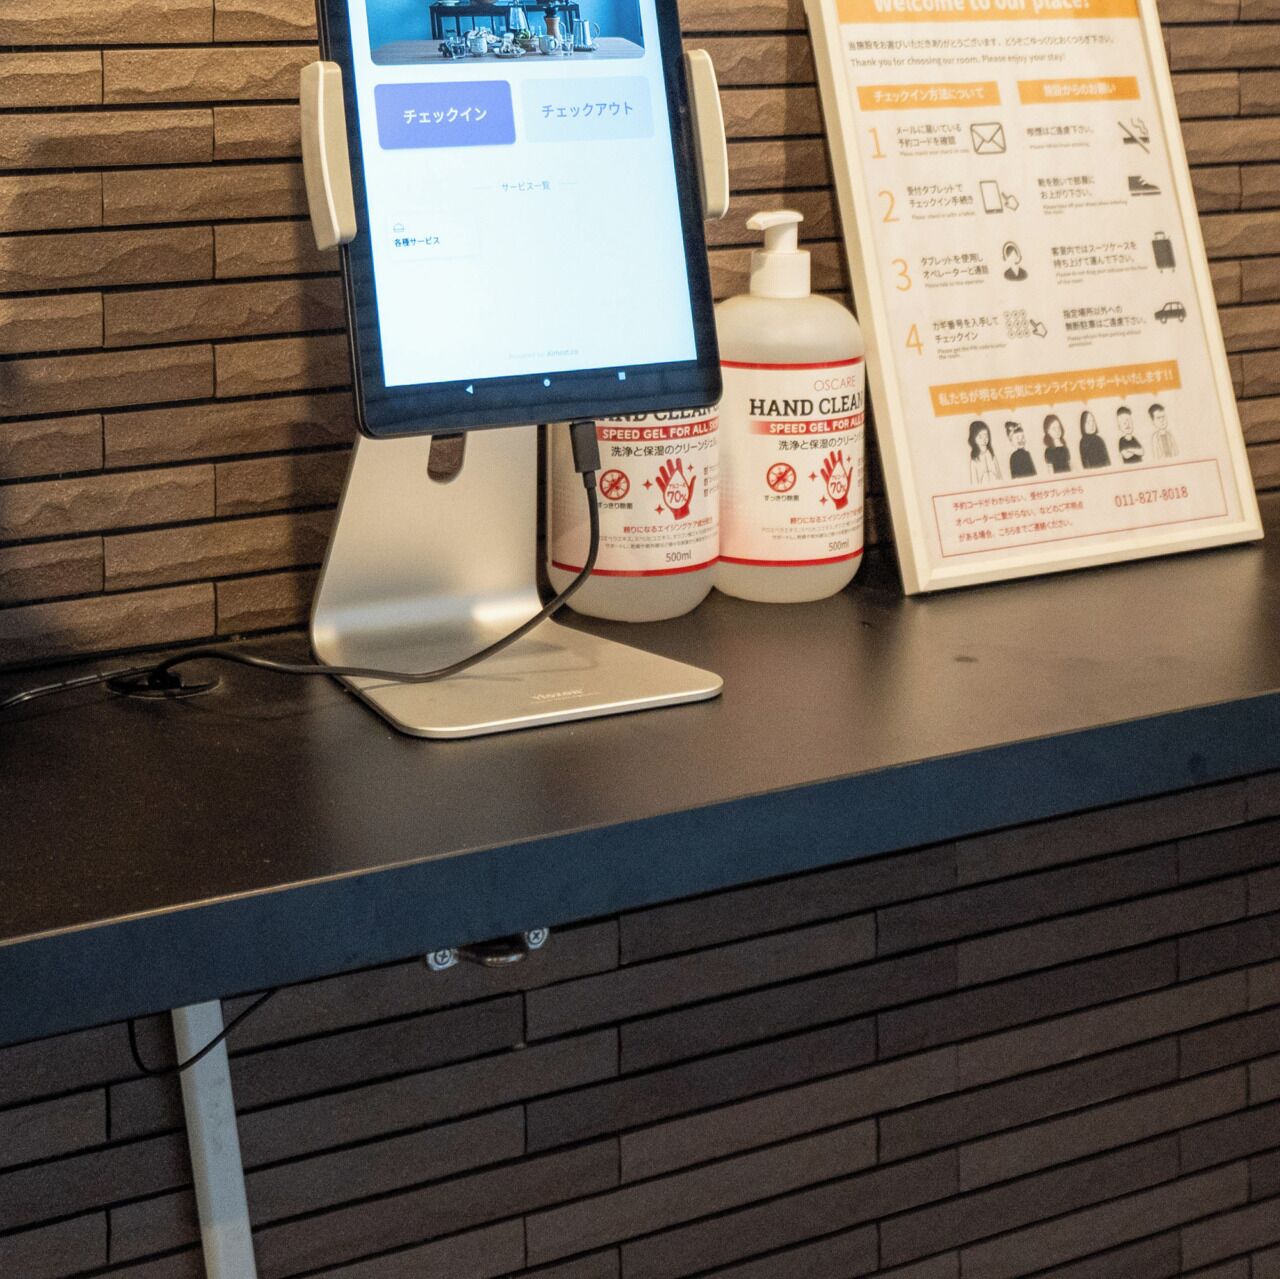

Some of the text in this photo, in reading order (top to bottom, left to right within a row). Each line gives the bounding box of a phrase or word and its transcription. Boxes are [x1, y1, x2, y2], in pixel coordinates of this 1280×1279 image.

[851, 57, 876, 68] Thank
[879, 57, 892, 68] you
[893, 56, 904, 66] for
[403, 107, 488, 124] チェックイン
[541, 101, 634, 119] チェックアウト
[868, 127, 887, 159] 1
[501, 180, 552, 192] サービス一覧
[878, 190, 900, 224] 2
[393, 236, 441, 249] 各種サービス
[891, 258, 912, 292] 3
[905, 323, 925, 356] 4
[935, 331, 979, 345] チェックイン
[813, 375, 856, 392] OSCARE
[749, 397, 814, 416] HAND
[602, 429, 640, 440] SPEED
[643, 427, 667, 440] GEL
[669, 425, 691, 438] FOR
[692, 421, 708, 436] ALL
[769, 423, 807, 434] SPEED
[809, 421, 831, 433] GEL
[832, 418, 850, 430] FOR
[667, 490, 687, 504] 70%
[1114, 485, 1189, 508] 011-827-8018
[829, 541, 849, 551] 500ml
[666, 549, 692, 563] 500ml
